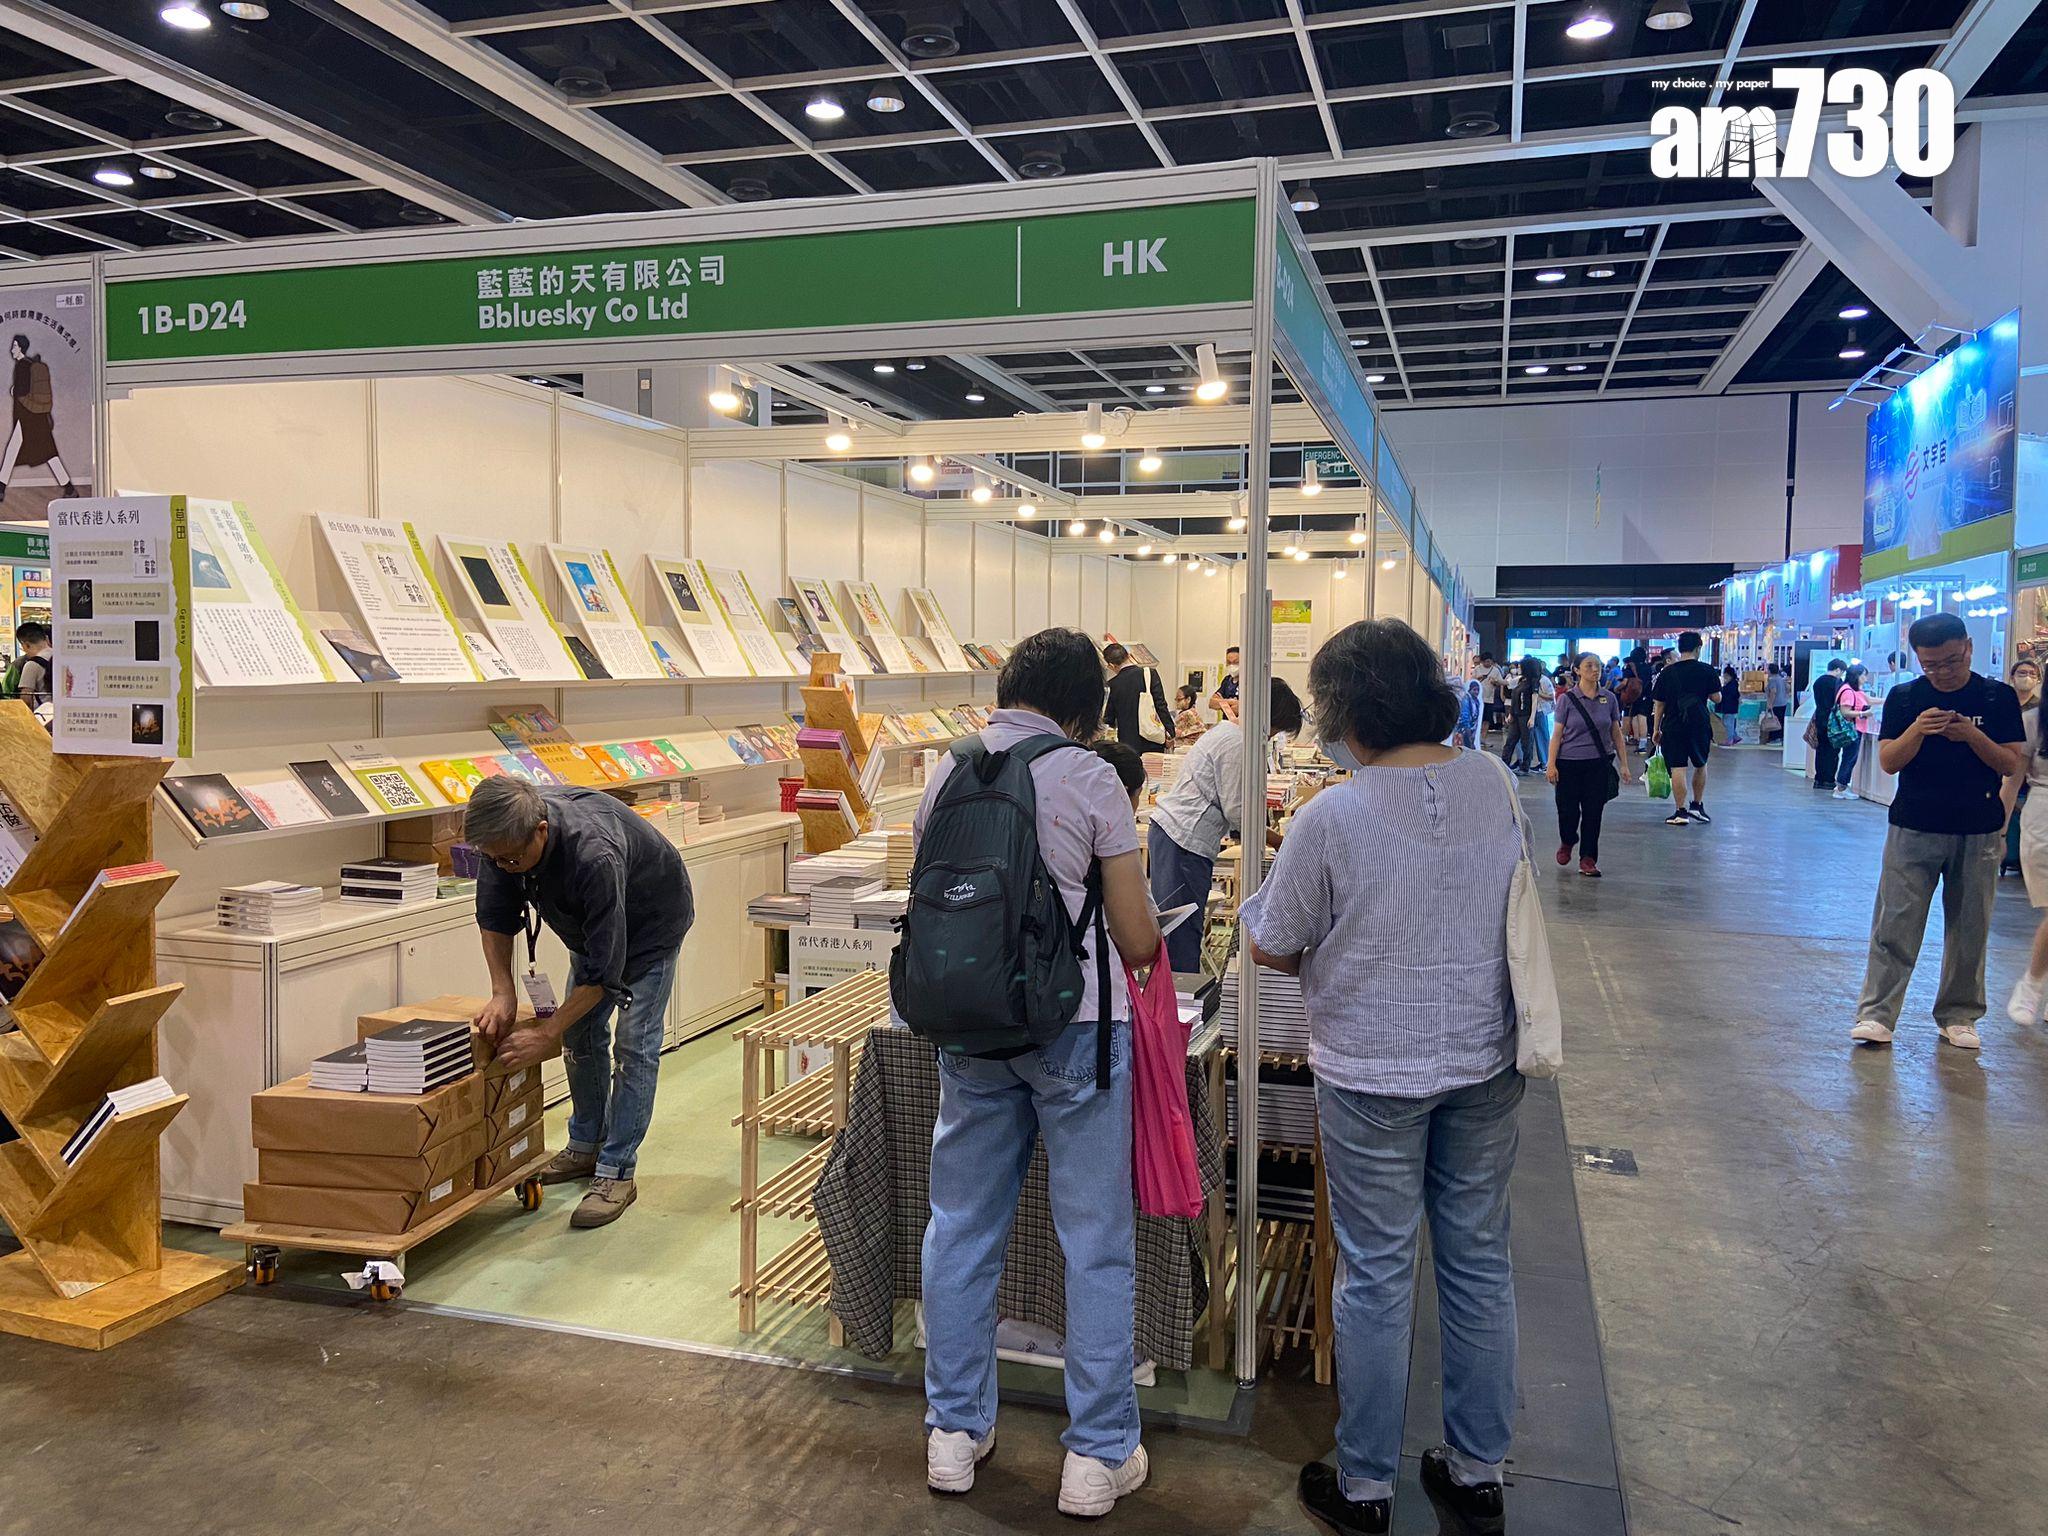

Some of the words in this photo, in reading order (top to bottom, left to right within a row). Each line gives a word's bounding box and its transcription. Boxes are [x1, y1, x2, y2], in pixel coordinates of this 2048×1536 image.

[1103, 237, 1168, 277] HK
[476, 255, 725, 299] 藍藍的天有限公司
[1276, 254, 1295, 313] B-D24
[138, 299, 247, 335] 1B-D24
[478, 299, 597, 331] Bbluesky
[605, 298, 638, 324] Co
[647, 293, 688, 321] Ltd
[57, 509, 140, 526] 當代香港人系列
[175, 508, 186, 540] 草田
[797, 935, 873, 951] 當代香港人系列
